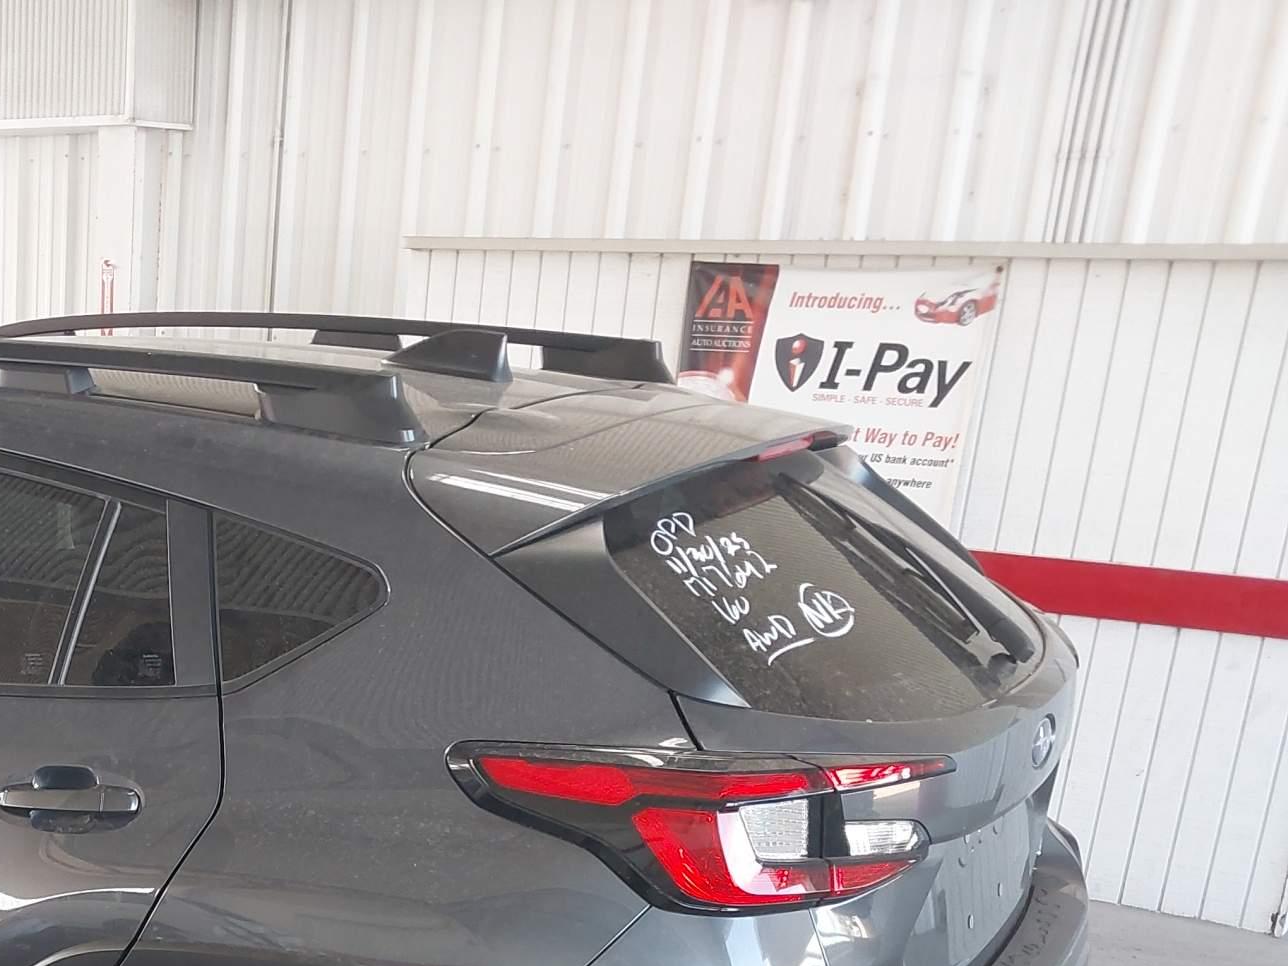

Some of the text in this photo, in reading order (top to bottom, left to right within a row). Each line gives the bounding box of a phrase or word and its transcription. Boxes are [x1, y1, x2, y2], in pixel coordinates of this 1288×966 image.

[789, 291, 901, 314] Introducing...
[692, 324, 753, 334] INSURANCE
[691, 338, 751, 348] AUTO AUCTIONS
[818, 341, 973, 408] I-Pay
[812, 393, 846, 403] SIMPLE
[853, 395, 877, 405] SAFE
[886, 397, 924, 408] SECURE
[864, 427, 898, 448] Way
[901, 430, 918, 446] to
[920, 431, 961, 452] Pay!
[870, 453, 884, 463] US
[885, 454, 908, 465] bank
